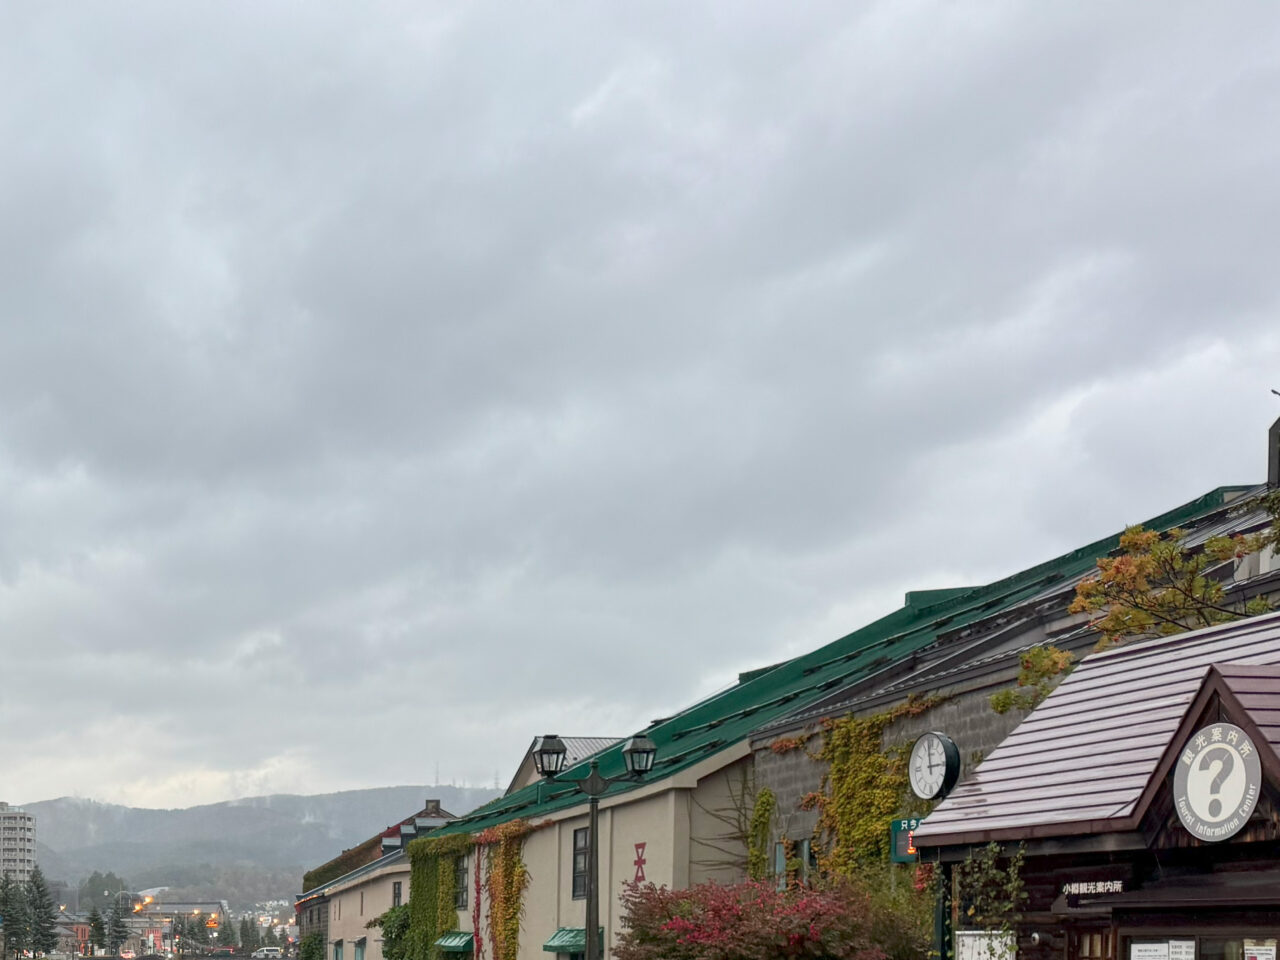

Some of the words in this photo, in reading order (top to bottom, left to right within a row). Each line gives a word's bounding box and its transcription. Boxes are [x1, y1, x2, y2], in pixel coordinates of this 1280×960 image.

[1182, 727, 1253, 766] 観光案内所
[1178, 795, 1195, 826] Tourist
[1195, 818, 1239, 836] Information
[1239, 783, 1257, 817] Center
[1063, 881, 1123, 894] 小樽観光案内所
